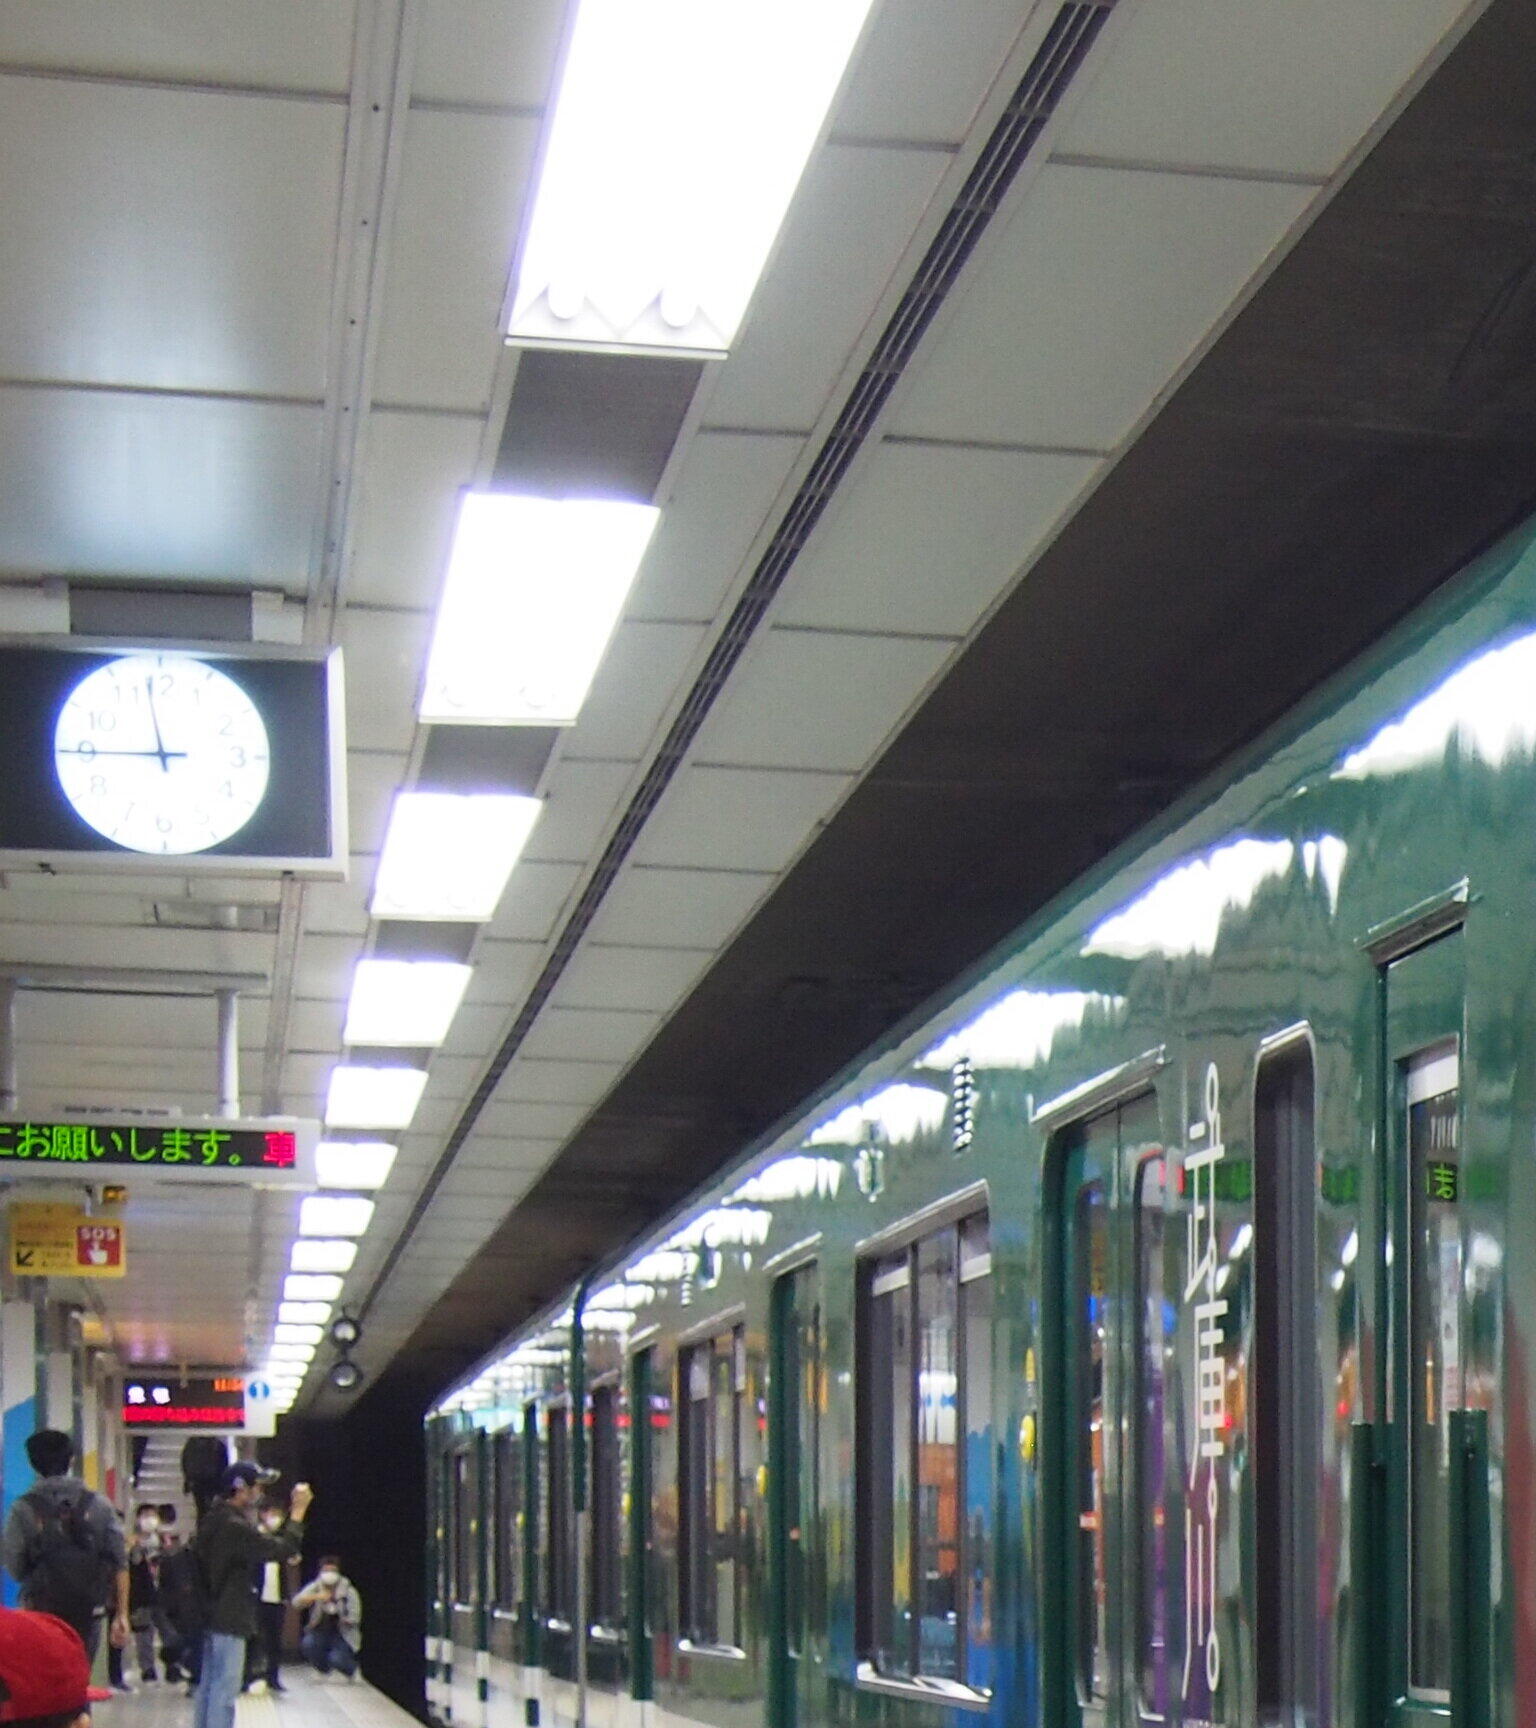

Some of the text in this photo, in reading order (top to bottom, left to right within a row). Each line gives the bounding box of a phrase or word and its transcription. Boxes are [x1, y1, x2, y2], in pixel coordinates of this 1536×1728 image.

[89, 710, 116, 732] 10
[230, 746, 246, 768] 3
[90, 775, 107, 796] 8
[263, 1130, 296, 1168] 車
[79, 1227, 117, 1241] SOS
[1182, 1063, 1228, 1700] 武庫川
